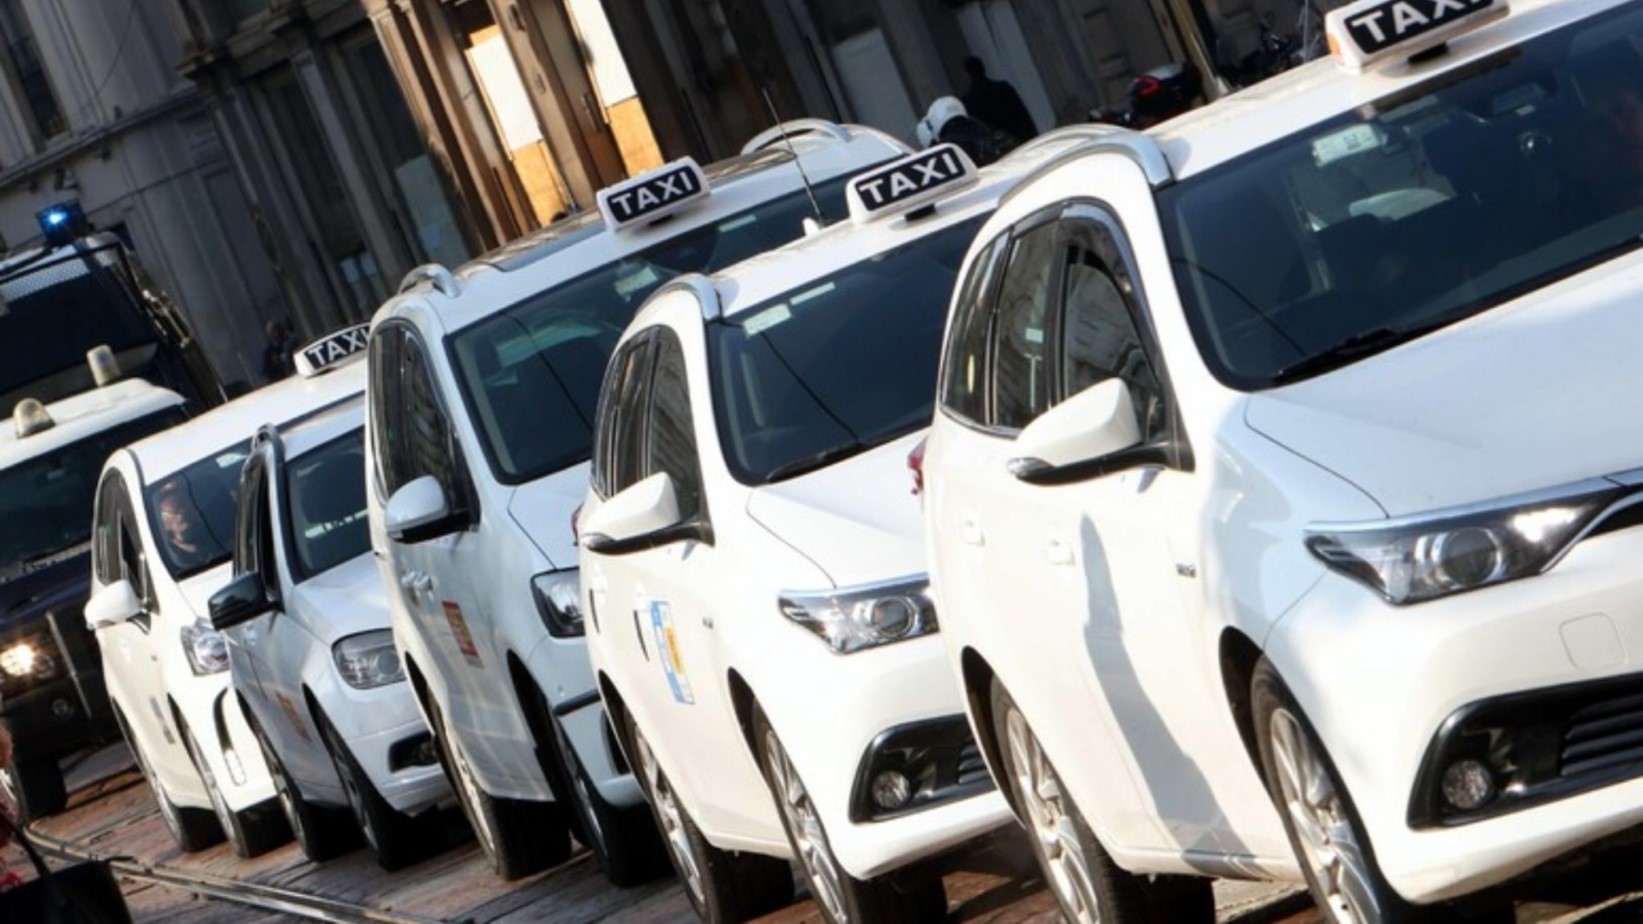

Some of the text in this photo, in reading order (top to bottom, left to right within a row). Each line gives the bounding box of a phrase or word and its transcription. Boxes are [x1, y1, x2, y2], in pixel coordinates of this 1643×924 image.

[1351, 0, 1481, 43] TAX
[611, 171, 694, 216] TAXI
[858, 153, 959, 204] TAXI
